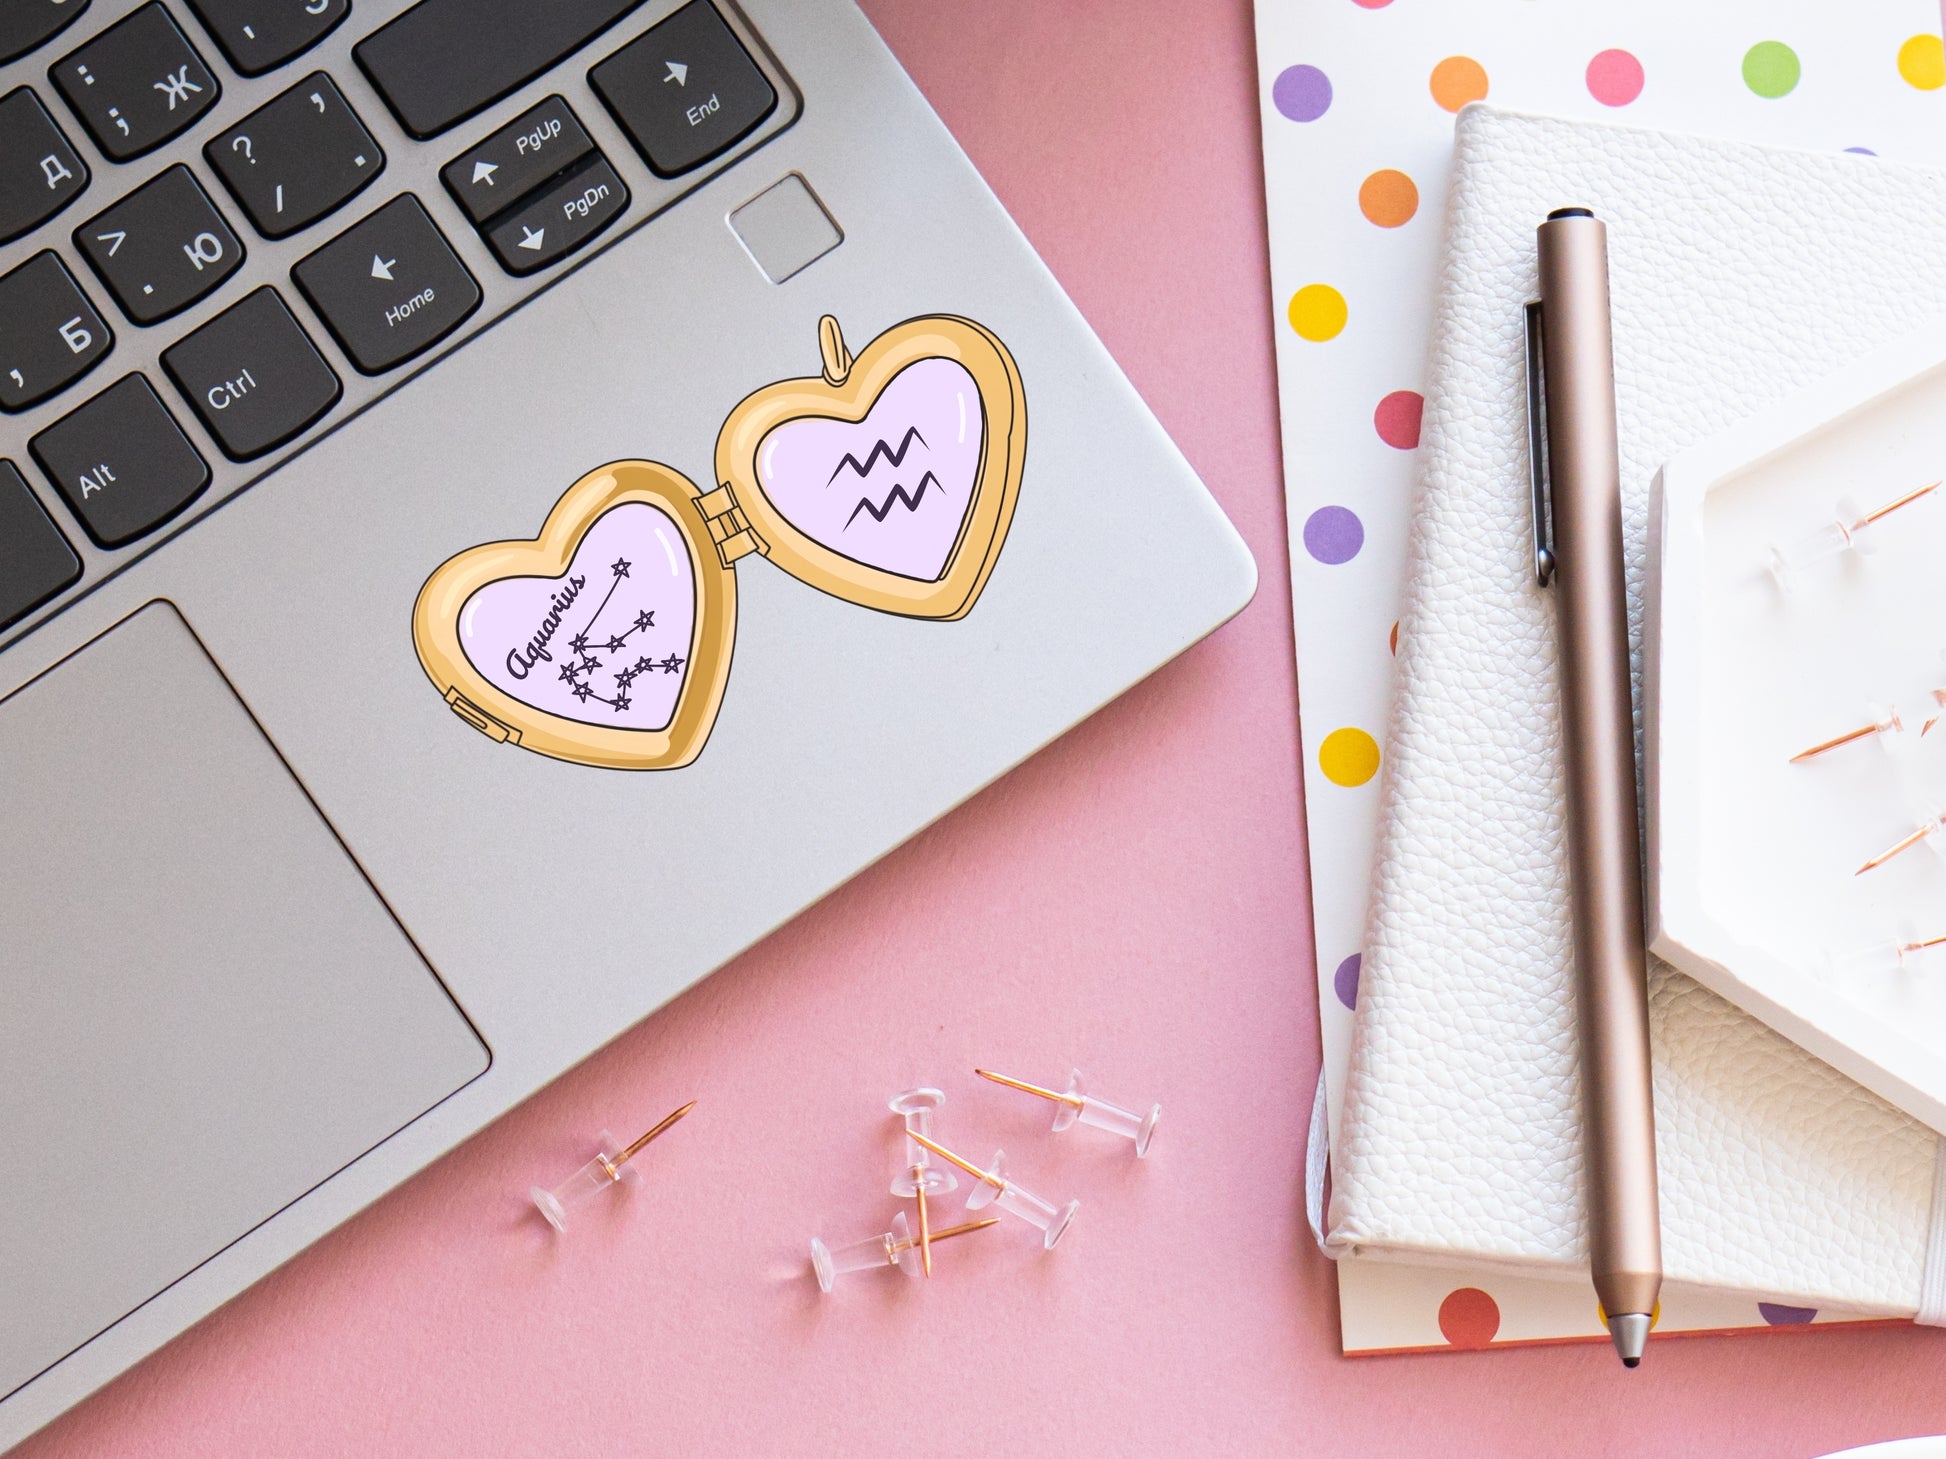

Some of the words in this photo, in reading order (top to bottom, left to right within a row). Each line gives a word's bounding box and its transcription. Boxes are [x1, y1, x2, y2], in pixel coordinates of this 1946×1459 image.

[153, 64, 203, 111] Ж
[686, 93, 721, 127] End
[232, 135, 257, 165] ?
[515, 117, 562, 156] PgUp
[39, 154, 73, 190] Д
[563, 183, 610, 221] PgDn
[183, 232, 223, 271] Ю
[384, 287, 435, 327] Home
[58, 315, 93, 354] Б
[207, 368, 257, 410] Ctrl
[78, 463, 117, 500] Alt
[506, 574, 586, 680] Aquarius
